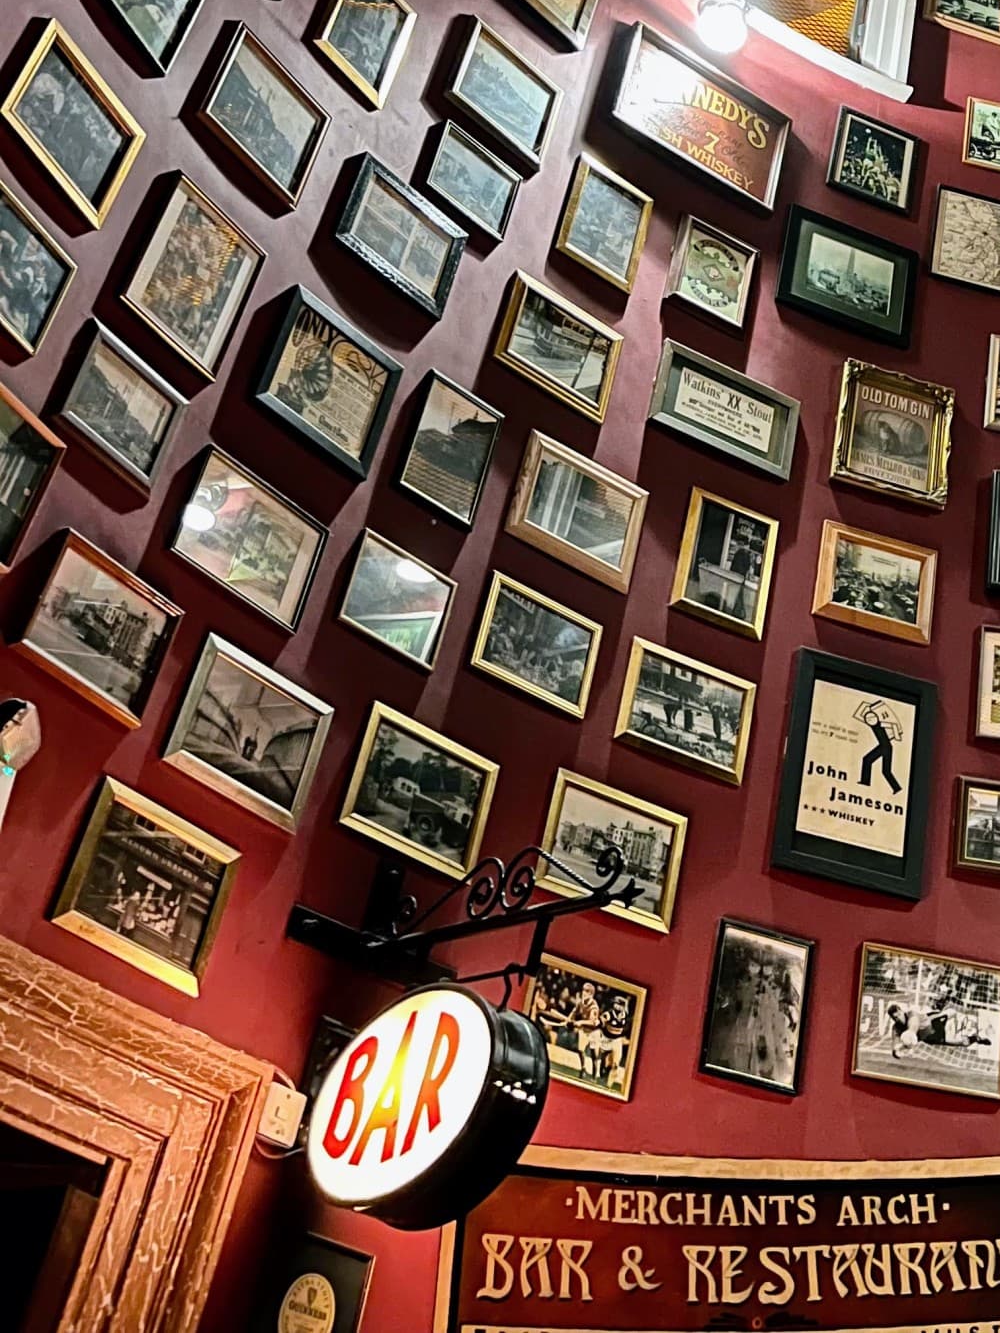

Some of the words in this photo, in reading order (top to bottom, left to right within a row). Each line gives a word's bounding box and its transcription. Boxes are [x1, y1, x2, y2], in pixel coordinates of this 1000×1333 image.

[687, 141, 754, 191] WHISKEY
[727, 392, 742, 411] XX
[861, 386, 883, 405] OLD
[884, 391, 908, 412] TOM
[910, 401, 931, 419] GIN
[808, 760, 848, 782] John
[829, 786, 904, 816] Jameson
[828, 808, 875, 827] WHISKEY
[322, 1010, 460, 1166] BAR
[476, 1233, 594, 1302] BAR
[617, 1245, 663, 1293] &
